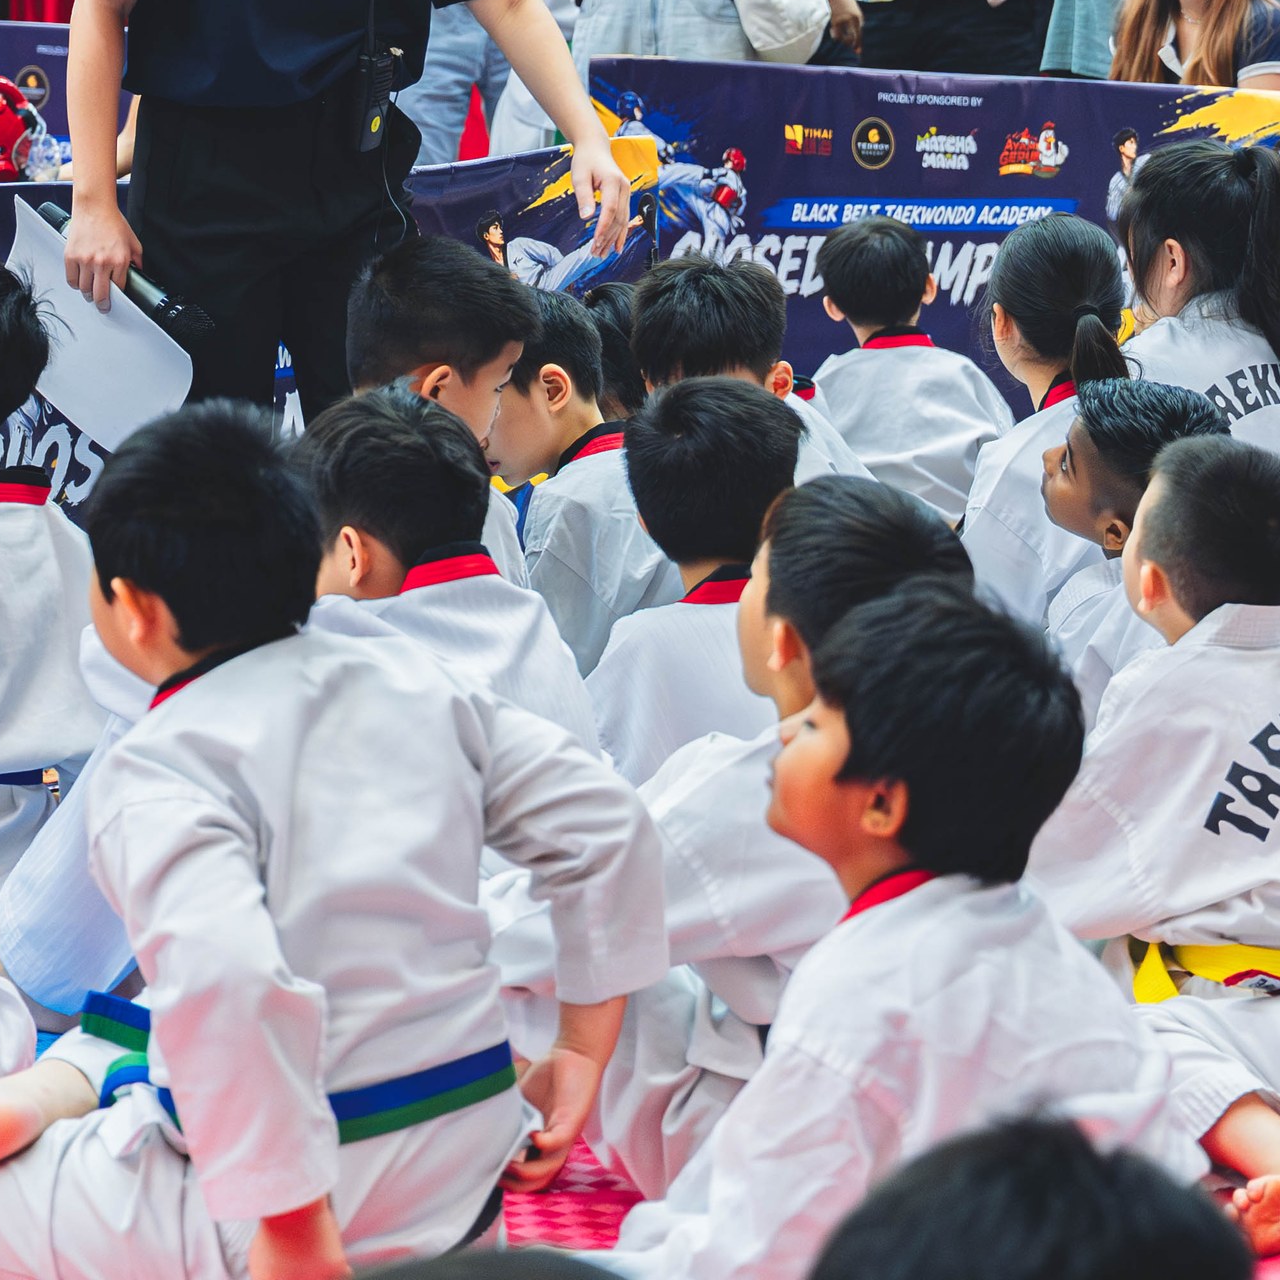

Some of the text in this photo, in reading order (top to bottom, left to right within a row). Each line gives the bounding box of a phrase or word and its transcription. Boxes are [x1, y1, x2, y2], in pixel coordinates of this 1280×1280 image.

[877, 91, 983, 108] PROUDLY SPONSORED BY
[803, 127, 833, 140] YIHAI
[791, 202, 839, 223] BLACK
[884, 205, 975, 226] TAEKWONDO
[977, 206, 1053, 225] ACADEMY
